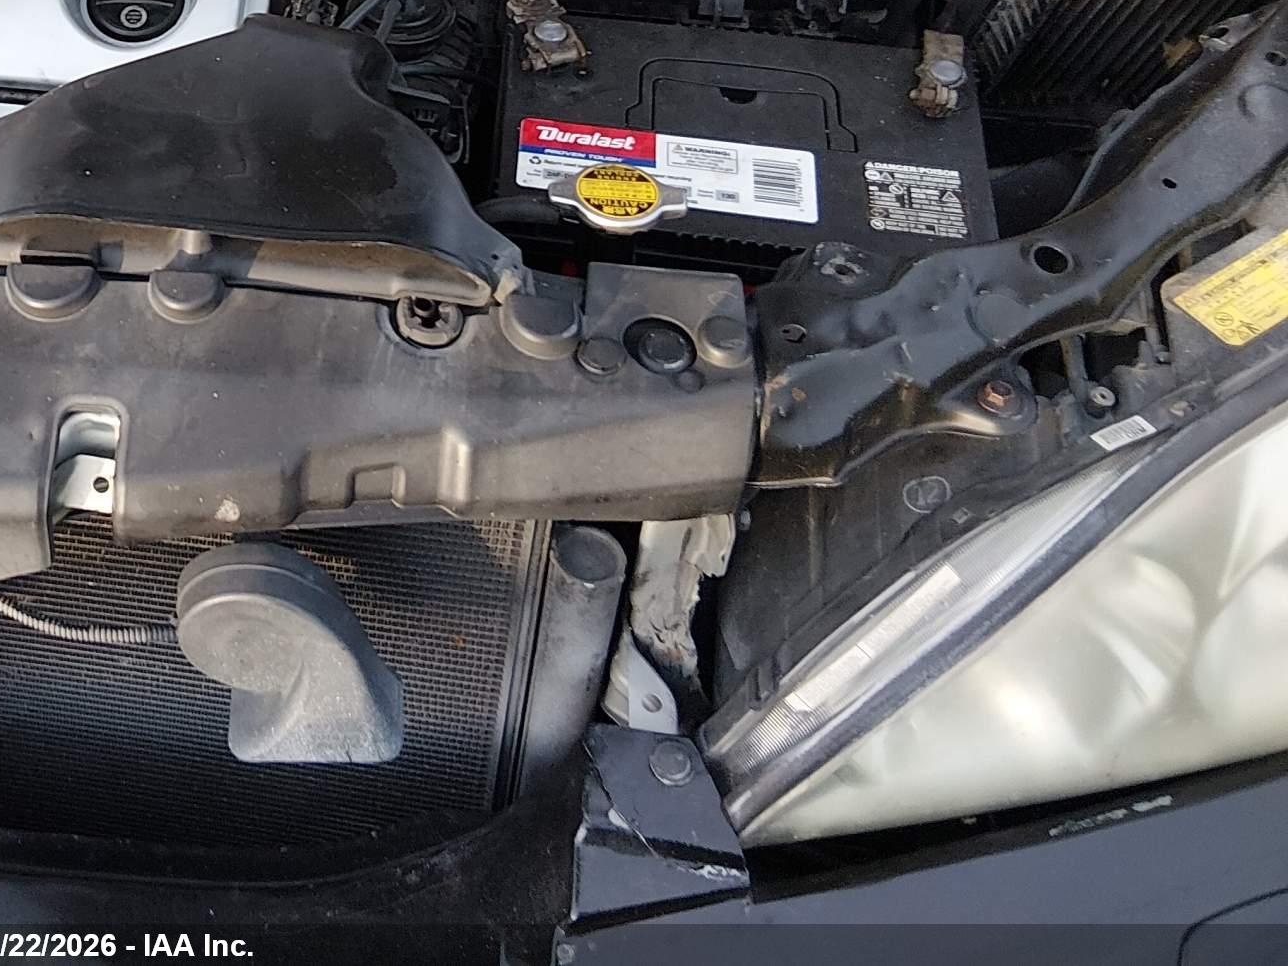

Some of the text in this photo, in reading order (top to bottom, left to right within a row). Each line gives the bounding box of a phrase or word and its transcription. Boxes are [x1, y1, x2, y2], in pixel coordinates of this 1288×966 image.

[535, 125, 637, 151] Duralast
[543, 148, 624, 163] PROVEN TOUGH
[589, 198, 649, 210] CAUTION
